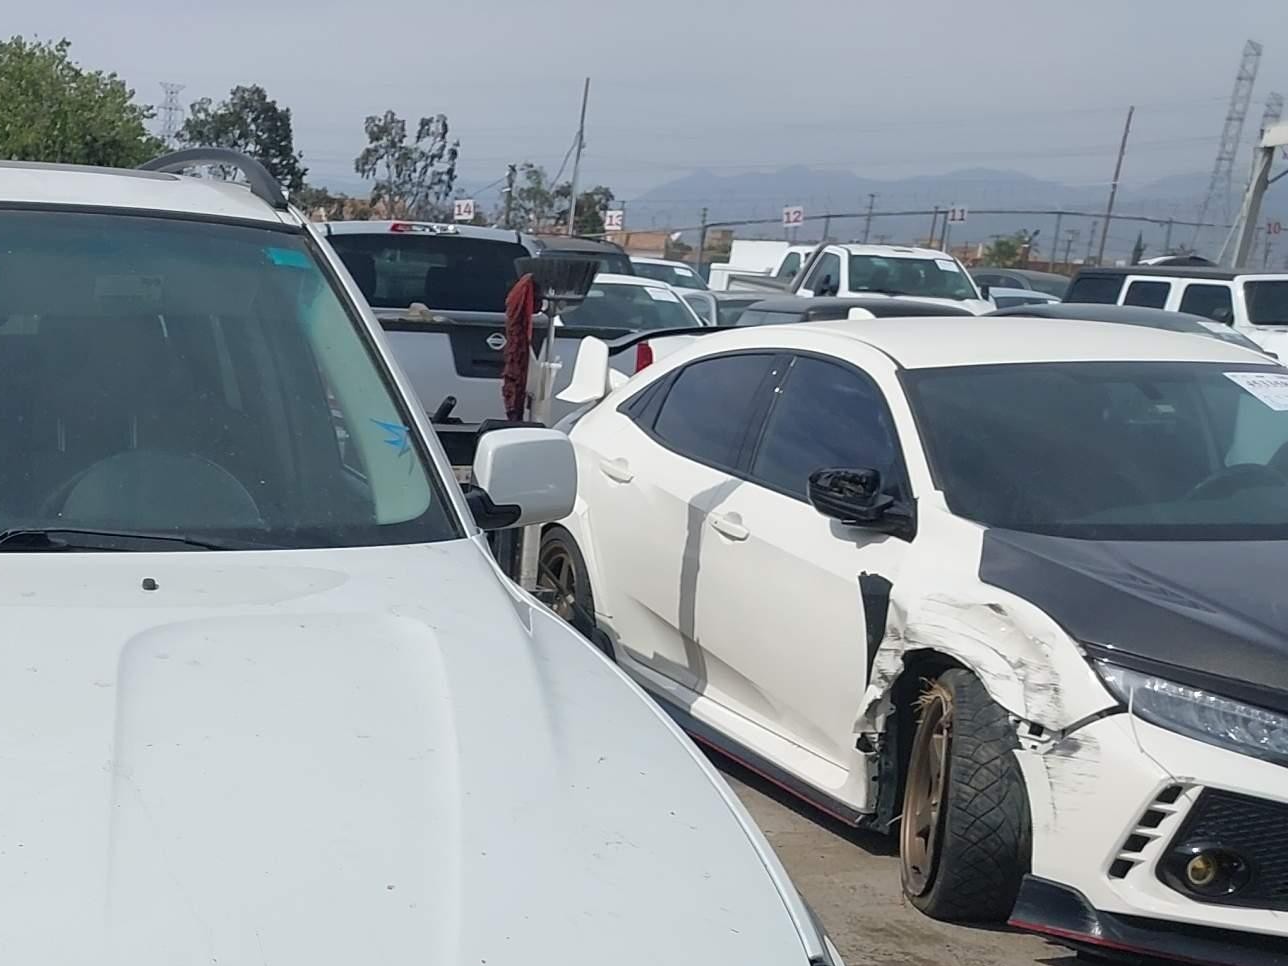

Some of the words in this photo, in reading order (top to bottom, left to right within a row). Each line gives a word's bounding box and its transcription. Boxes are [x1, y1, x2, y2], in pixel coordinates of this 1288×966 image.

[455, 203, 471, 216] 14
[948, 209, 965, 221] 11
[784, 210, 801, 224] 12
[1266, 223, 1281, 234] 10
